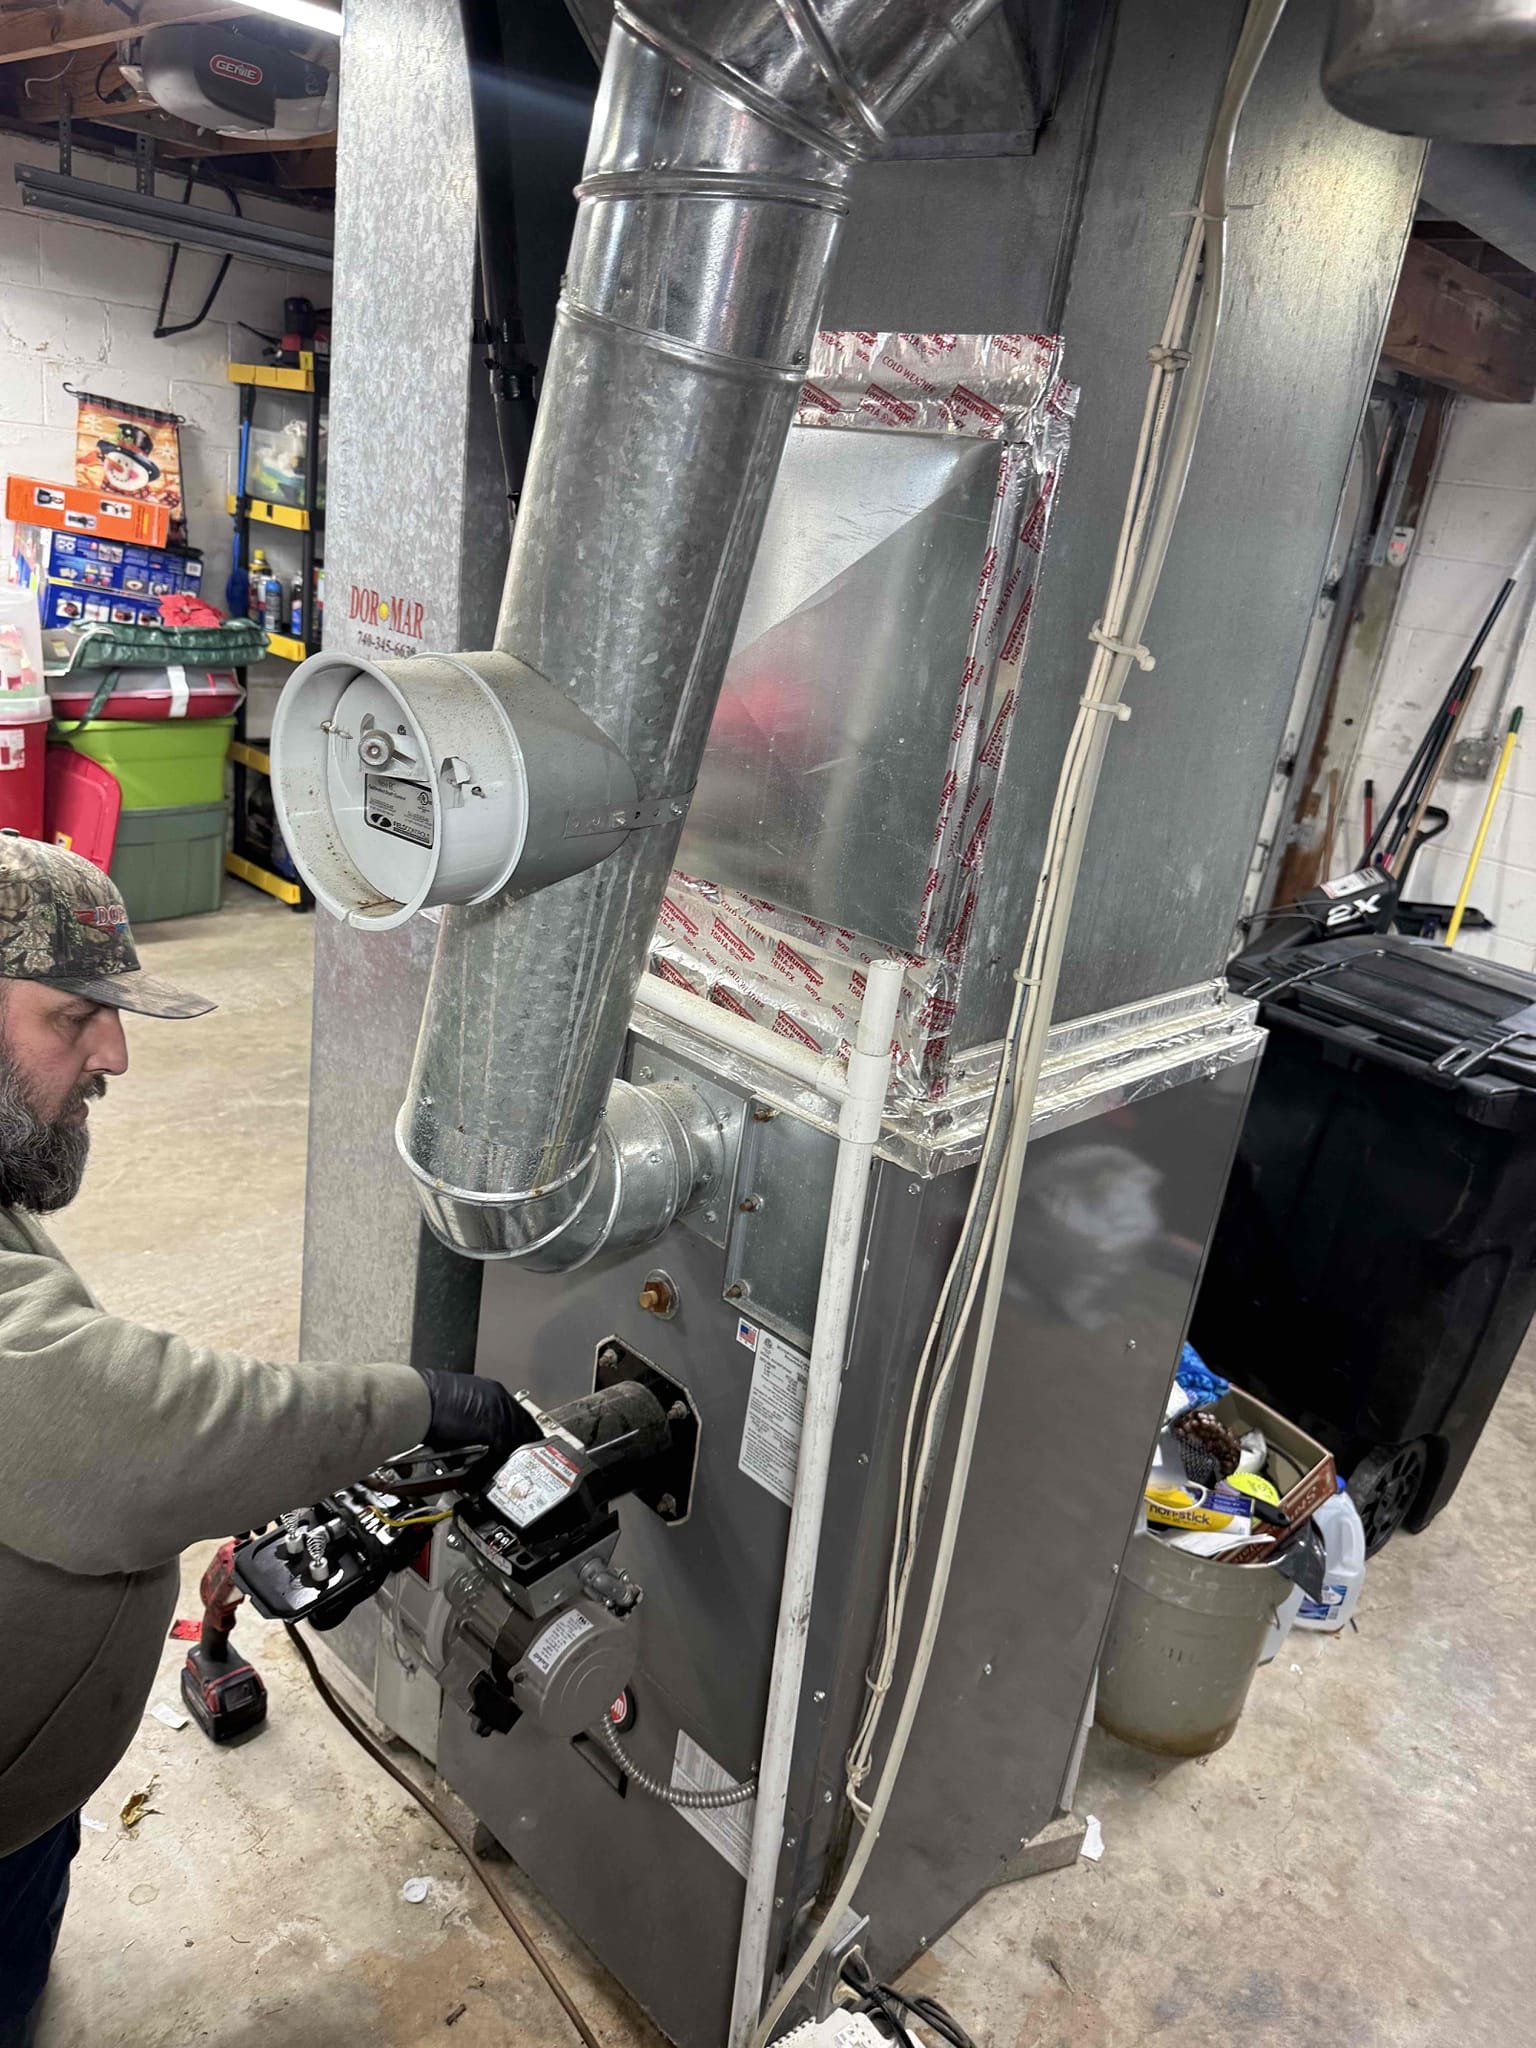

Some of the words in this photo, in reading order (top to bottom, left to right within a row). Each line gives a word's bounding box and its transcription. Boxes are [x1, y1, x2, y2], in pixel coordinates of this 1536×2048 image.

[216, 60, 257, 80] GENIE
[882, 356, 901, 374] COLD
[903, 368, 936, 393] WEATHER
[349, 585, 379, 626] DOR
[388, 595, 423, 640] MAR
[1327, 894, 1380, 926] 2X
[713, 917, 756, 962] VentureTape
[776, 943, 824, 988] VentureTape
